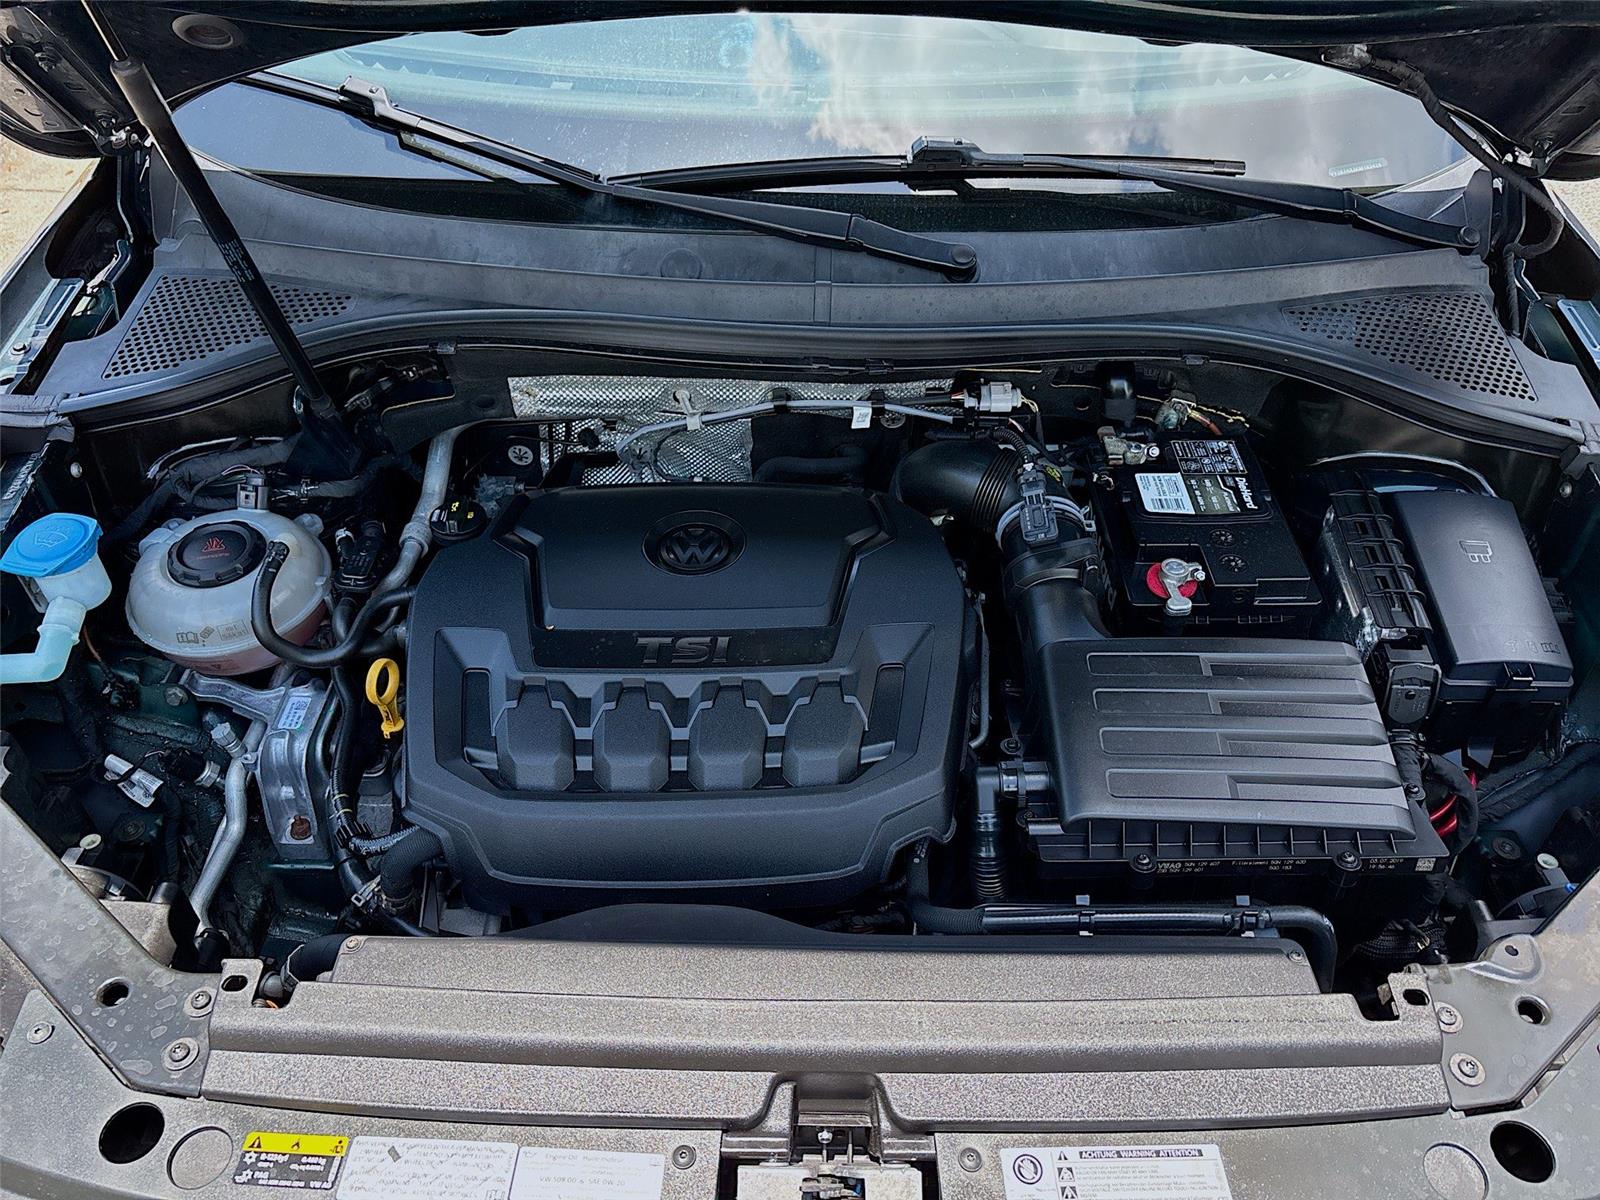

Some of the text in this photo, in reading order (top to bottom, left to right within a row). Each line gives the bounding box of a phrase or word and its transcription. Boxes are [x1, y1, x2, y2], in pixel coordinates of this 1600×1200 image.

[1235, 476, 1258, 510] DieHard
[636, 636, 732, 664] TSI
[1081, 1148, 1200, 1159] ACHTUNG WARNING ATTENTION
